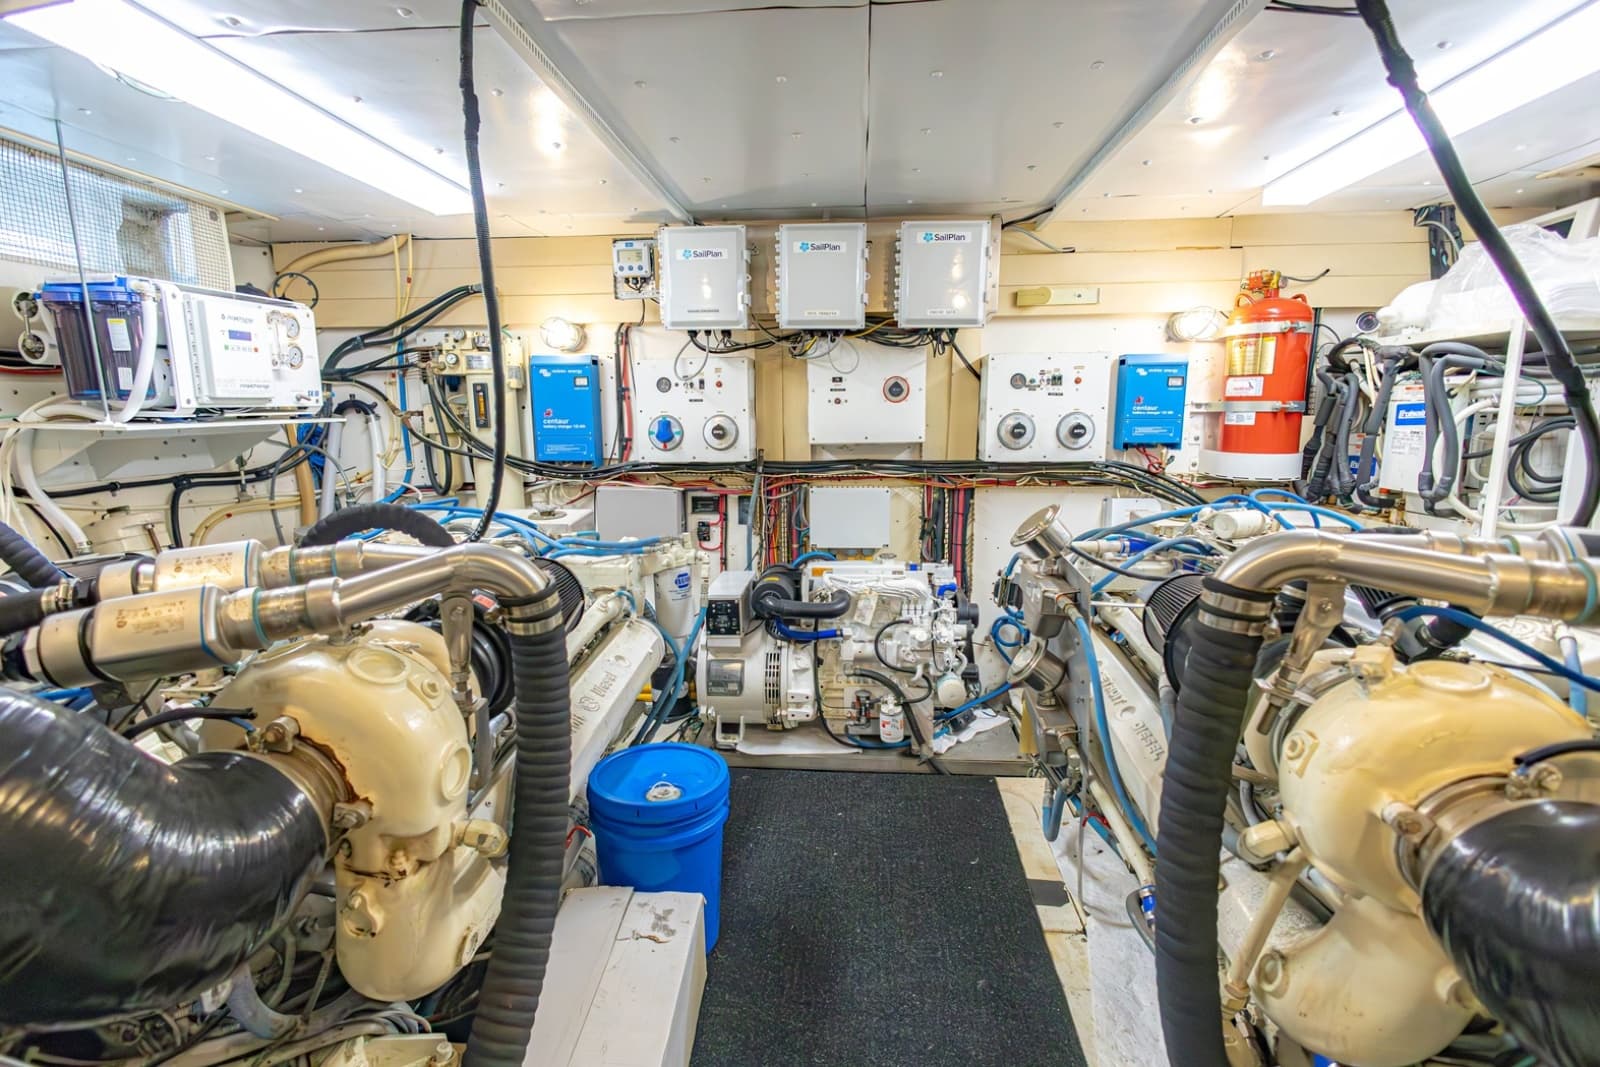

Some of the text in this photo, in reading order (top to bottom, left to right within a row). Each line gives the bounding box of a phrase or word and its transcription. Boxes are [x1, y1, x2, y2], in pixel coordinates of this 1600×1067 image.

[934, 232, 966, 242] SailPlan
[810, 241, 841, 252] SailPlan
[692, 249, 723, 259] SailPlan
